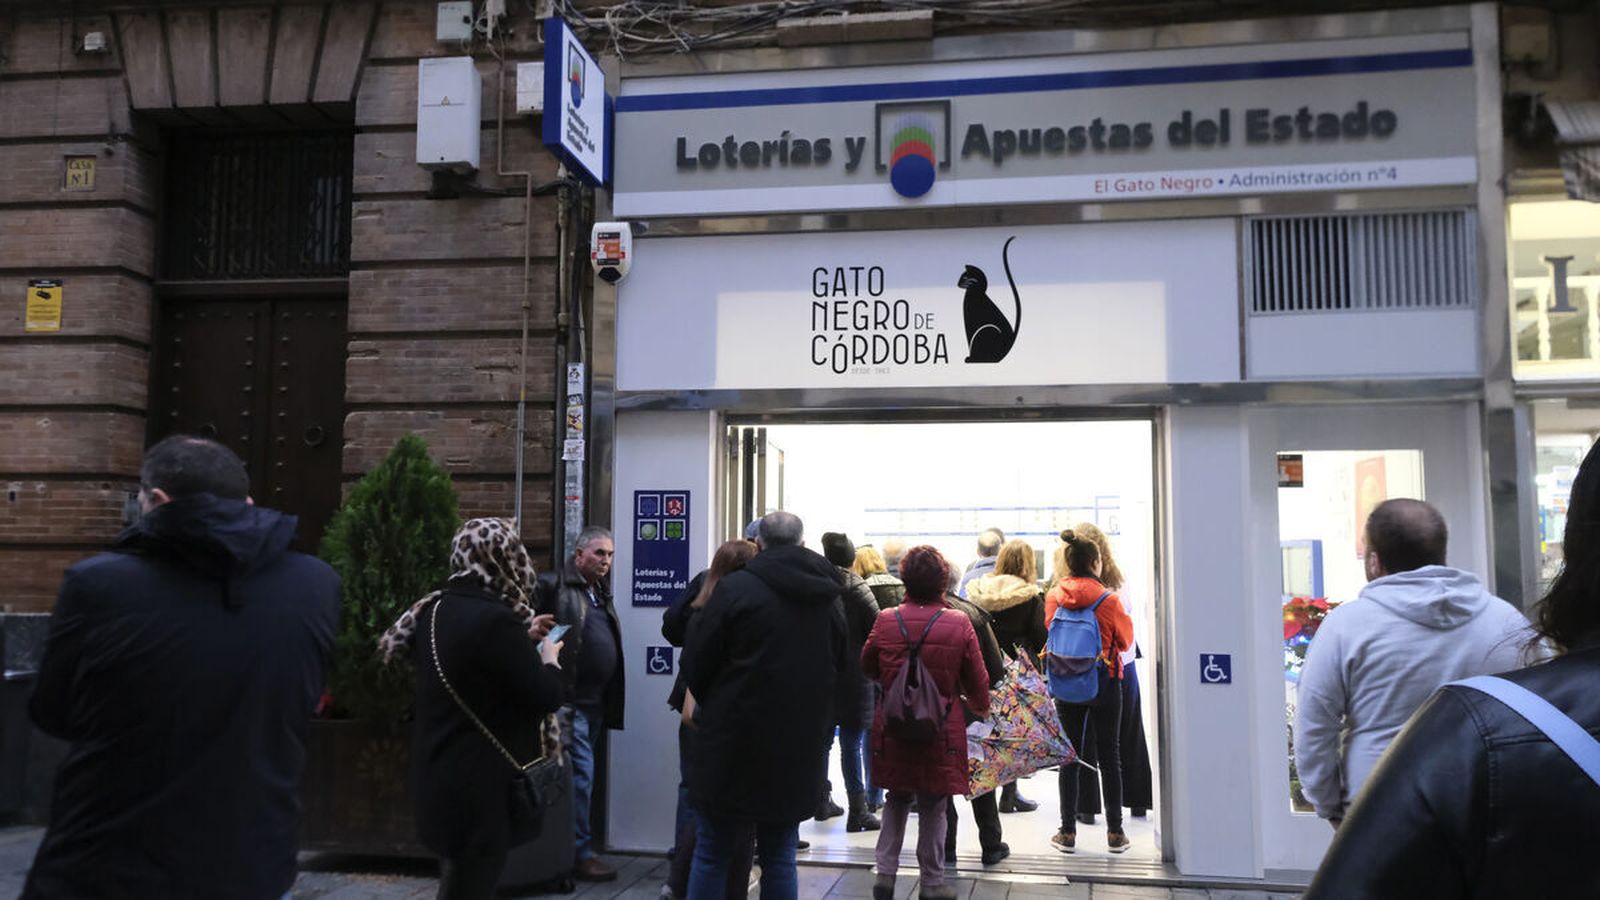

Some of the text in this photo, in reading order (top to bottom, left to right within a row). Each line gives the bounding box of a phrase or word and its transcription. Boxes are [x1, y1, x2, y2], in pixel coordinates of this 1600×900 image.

[676, 101, 1397, 173] Loterías y Apuestas del Estado
[1094, 179, 1109, 193] El
[1114, 178, 1154, 193] Gato
[1161, 176, 1213, 192] Negro
[1229, 168, 1361, 187] Administración
[812, 266, 884, 297] GATO
[812, 299, 935, 331] NEGRO DE
[811, 333, 949, 374] CÓRDOBA
[635, 581, 687, 590] Apuestas del
[669, 570, 675, 578] y
[635, 593, 662, 601] Estado
